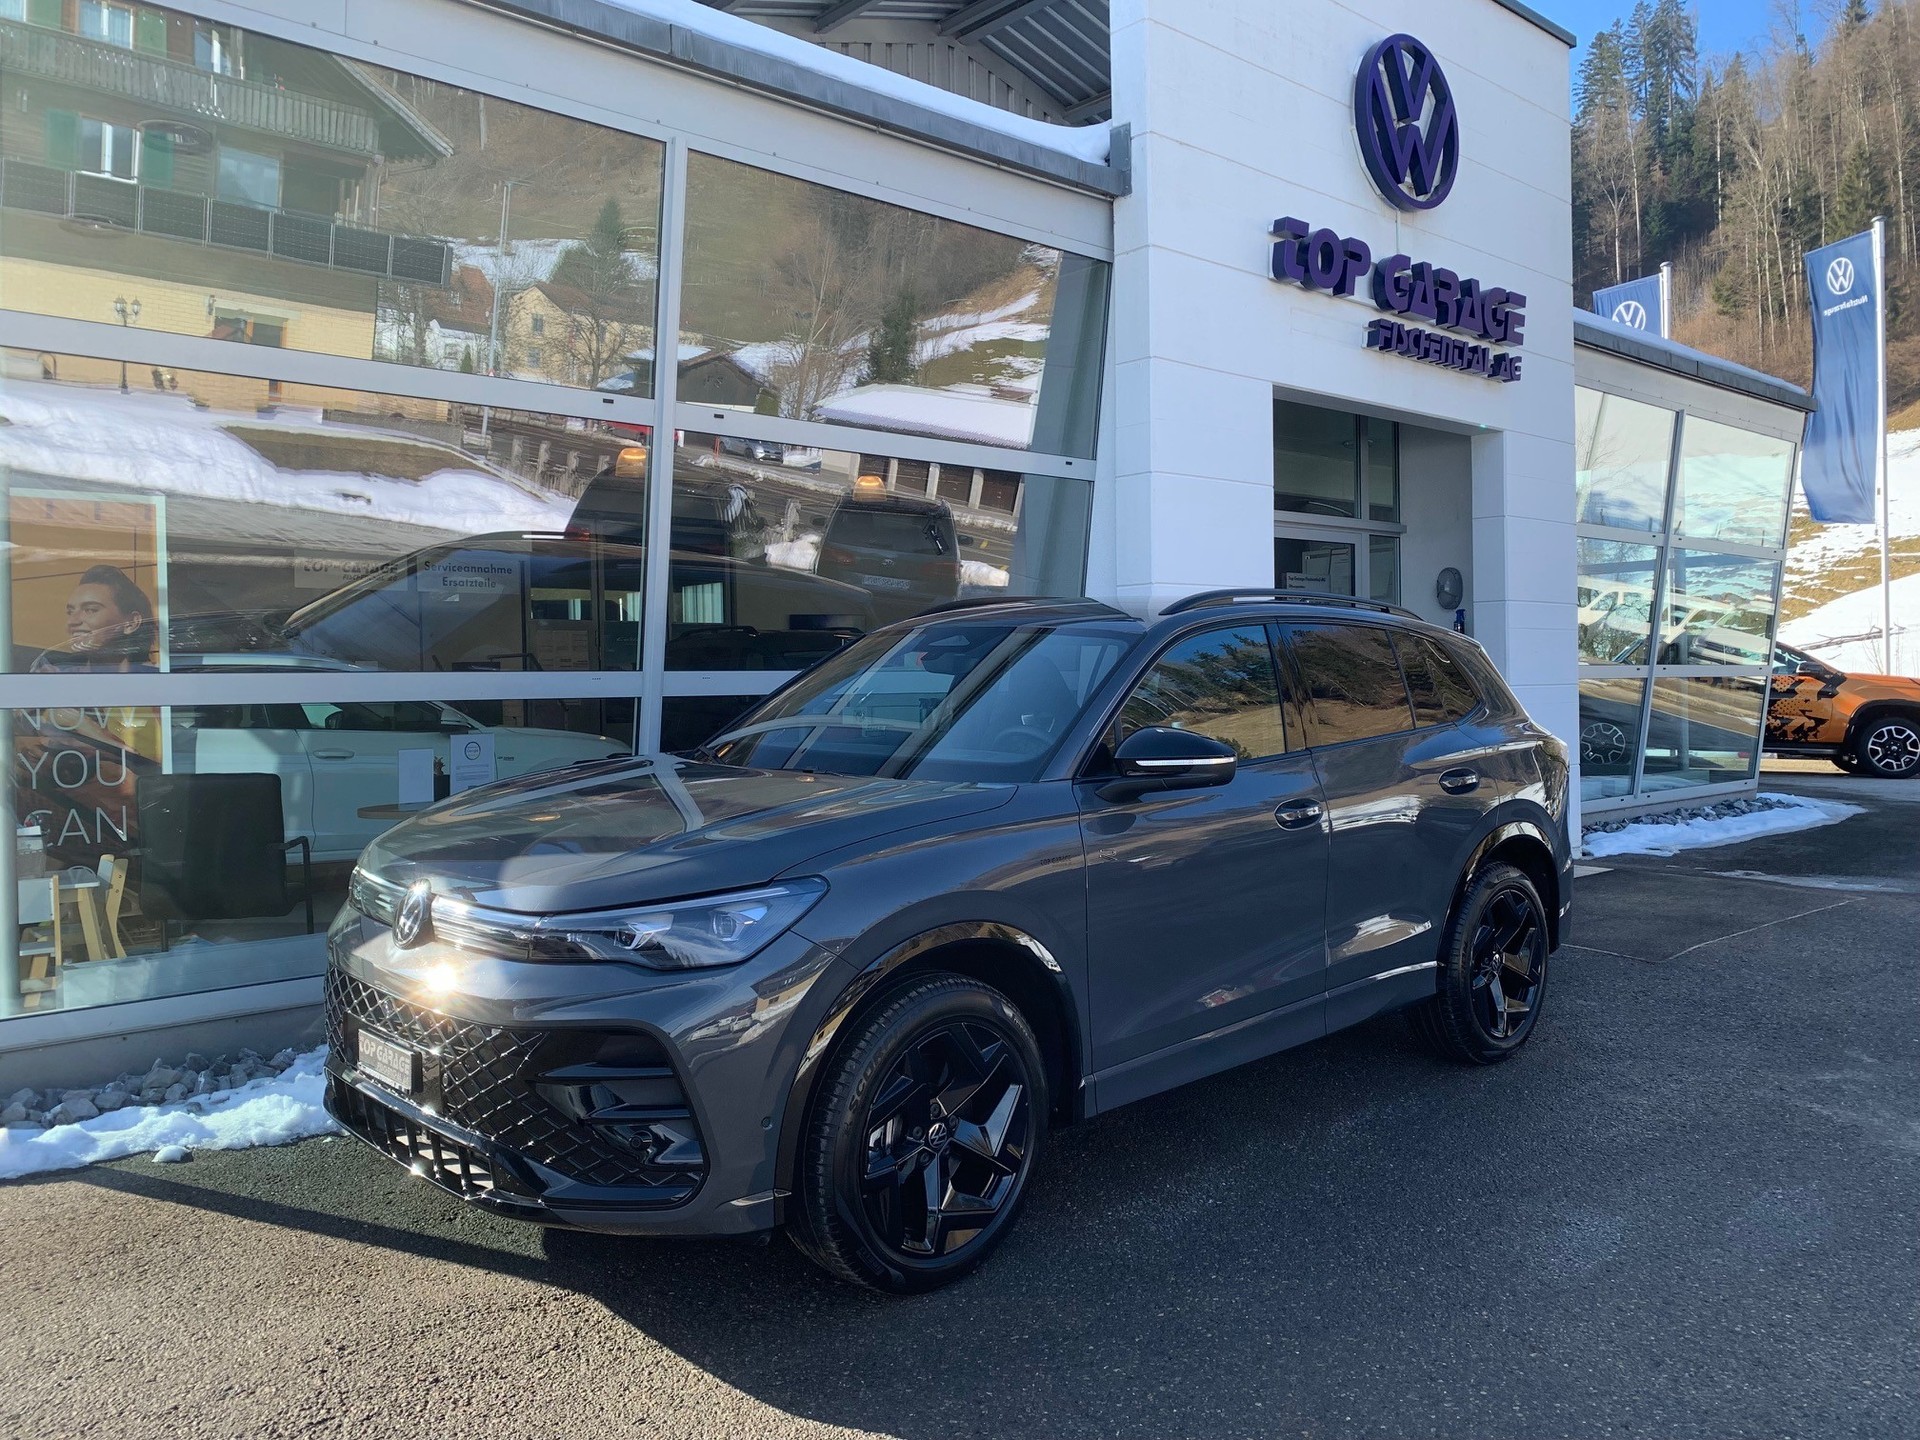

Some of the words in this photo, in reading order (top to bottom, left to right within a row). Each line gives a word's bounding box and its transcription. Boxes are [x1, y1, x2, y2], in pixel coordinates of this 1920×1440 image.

[1269, 216, 1371, 297] TOP
[1373, 254, 1526, 346] GARAGE
[1366, 318, 1494, 377] FISCHENTHAL
[1494, 352, 1523, 383] AG
[424, 561, 512, 574] Serviceannahme
[442, 577, 496, 588] Ersatzteile
[18, 750, 126, 789] YOU
[358, 1036, 376, 1057] TOP
[376, 1045, 411, 1075] GARAGE
